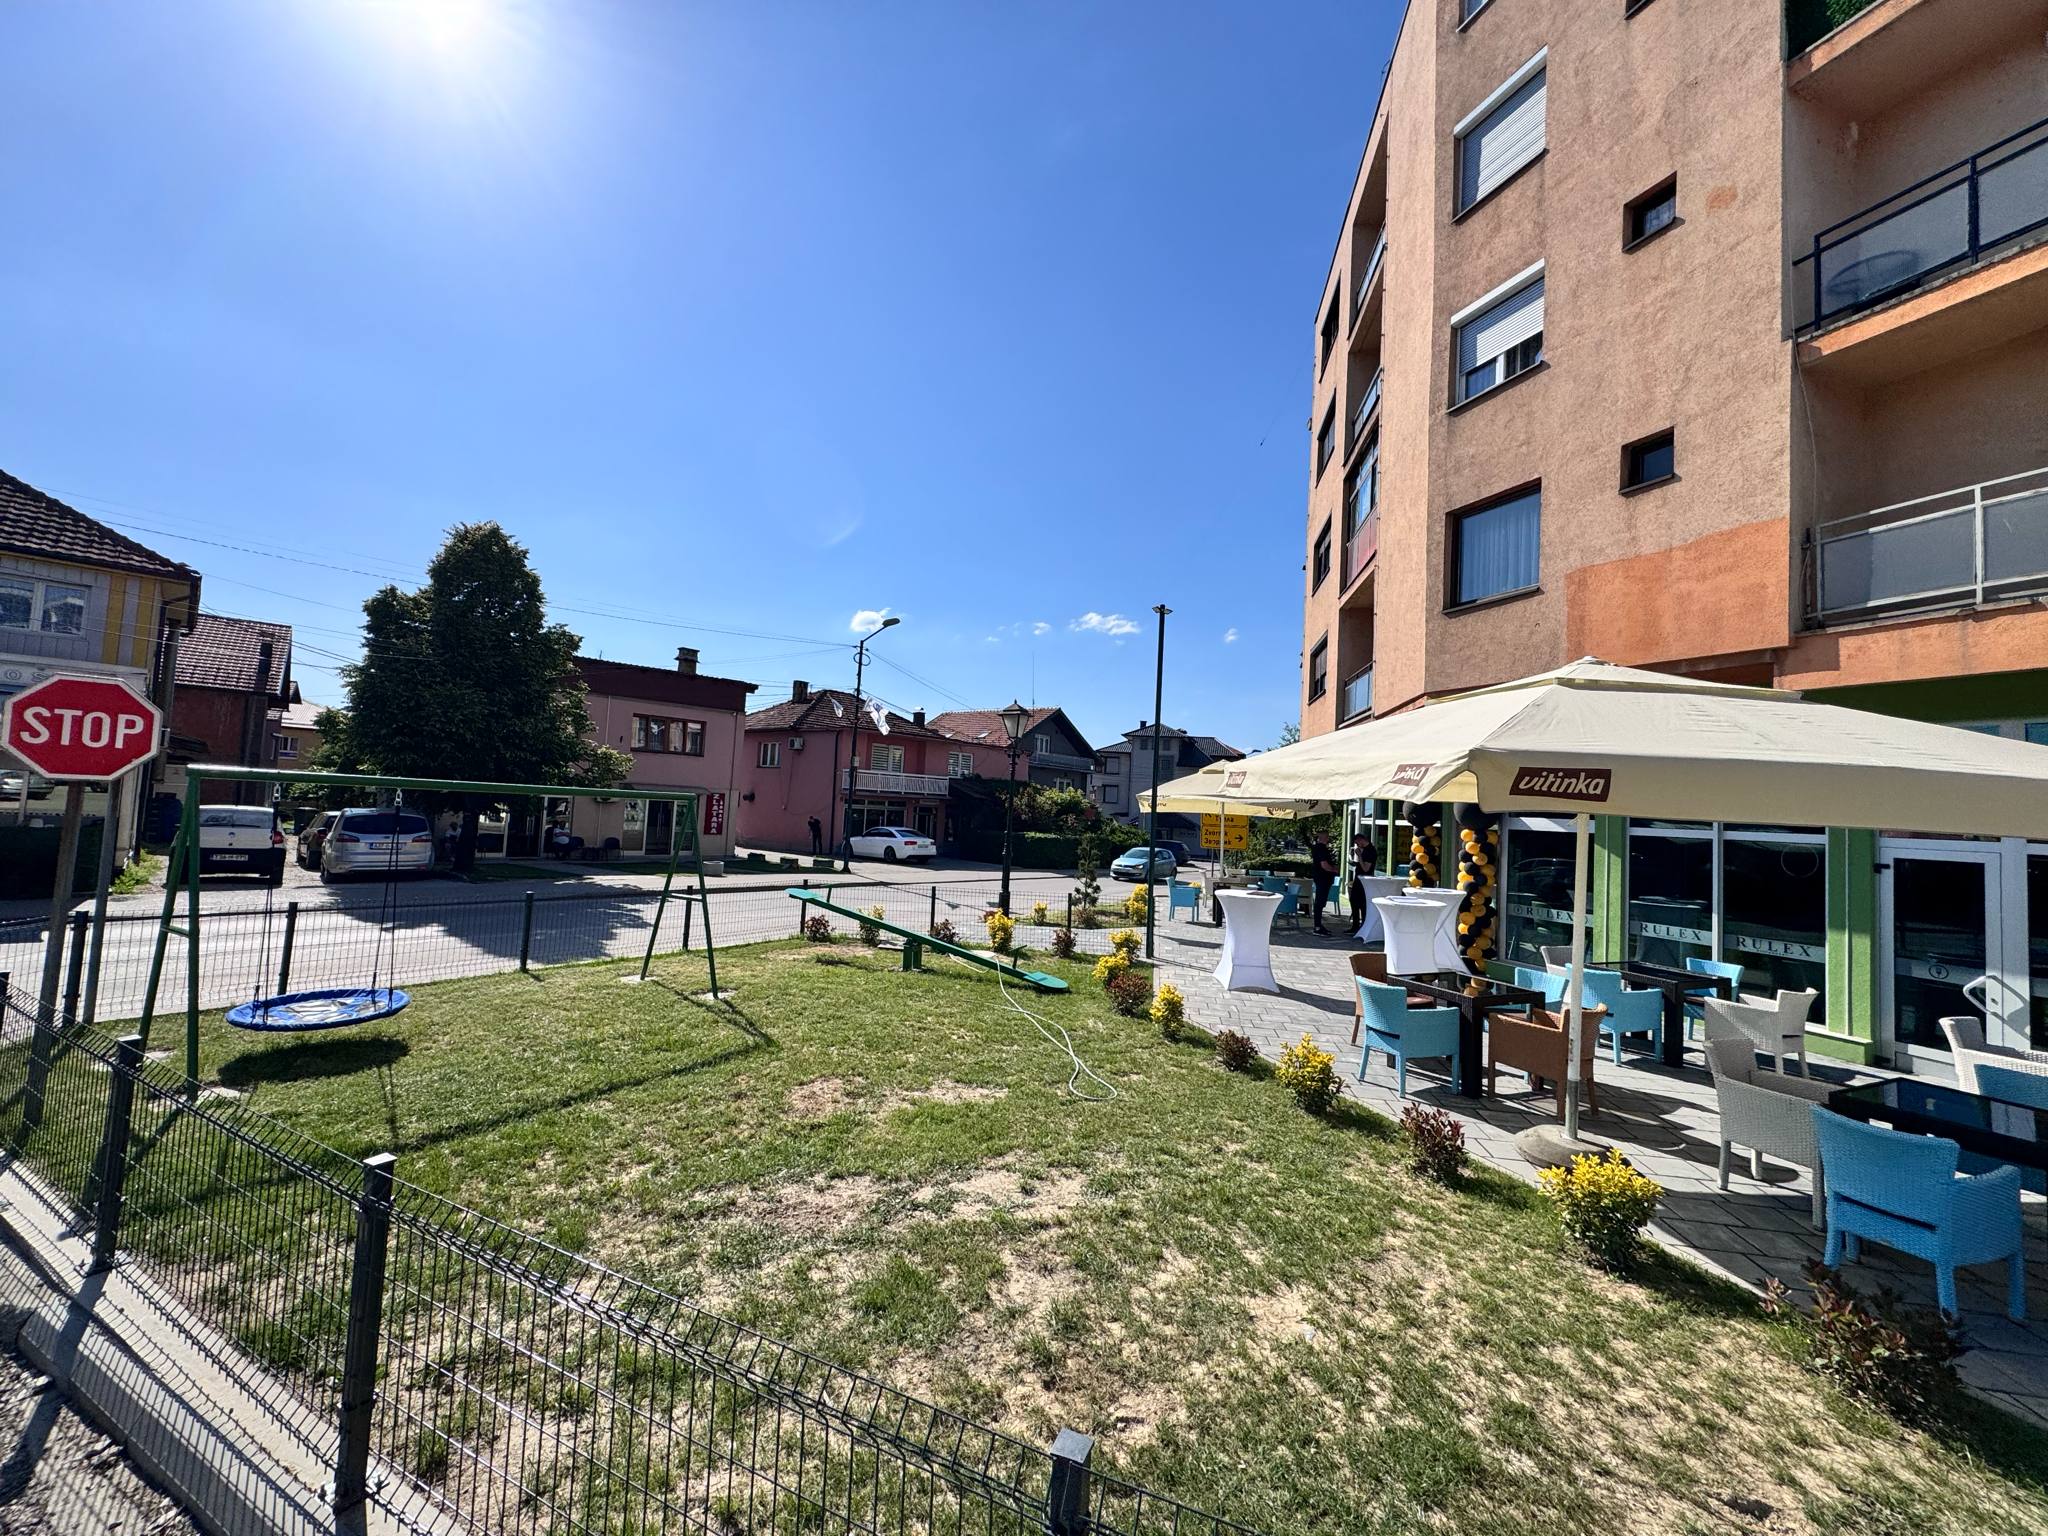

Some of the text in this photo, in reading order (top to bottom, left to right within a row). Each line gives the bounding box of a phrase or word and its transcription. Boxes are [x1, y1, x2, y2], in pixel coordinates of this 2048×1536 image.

[20, 706, 144, 749] STOP
[1518, 771, 1605, 795] vitinka
[711, 793, 720, 834] ZLATARA
[1204, 838, 1232, 846] Зворик
[1526, 907, 1574, 921] RULEX
[1640, 922, 1702, 941] RULEX
[1736, 936, 1811, 957] RULEX
